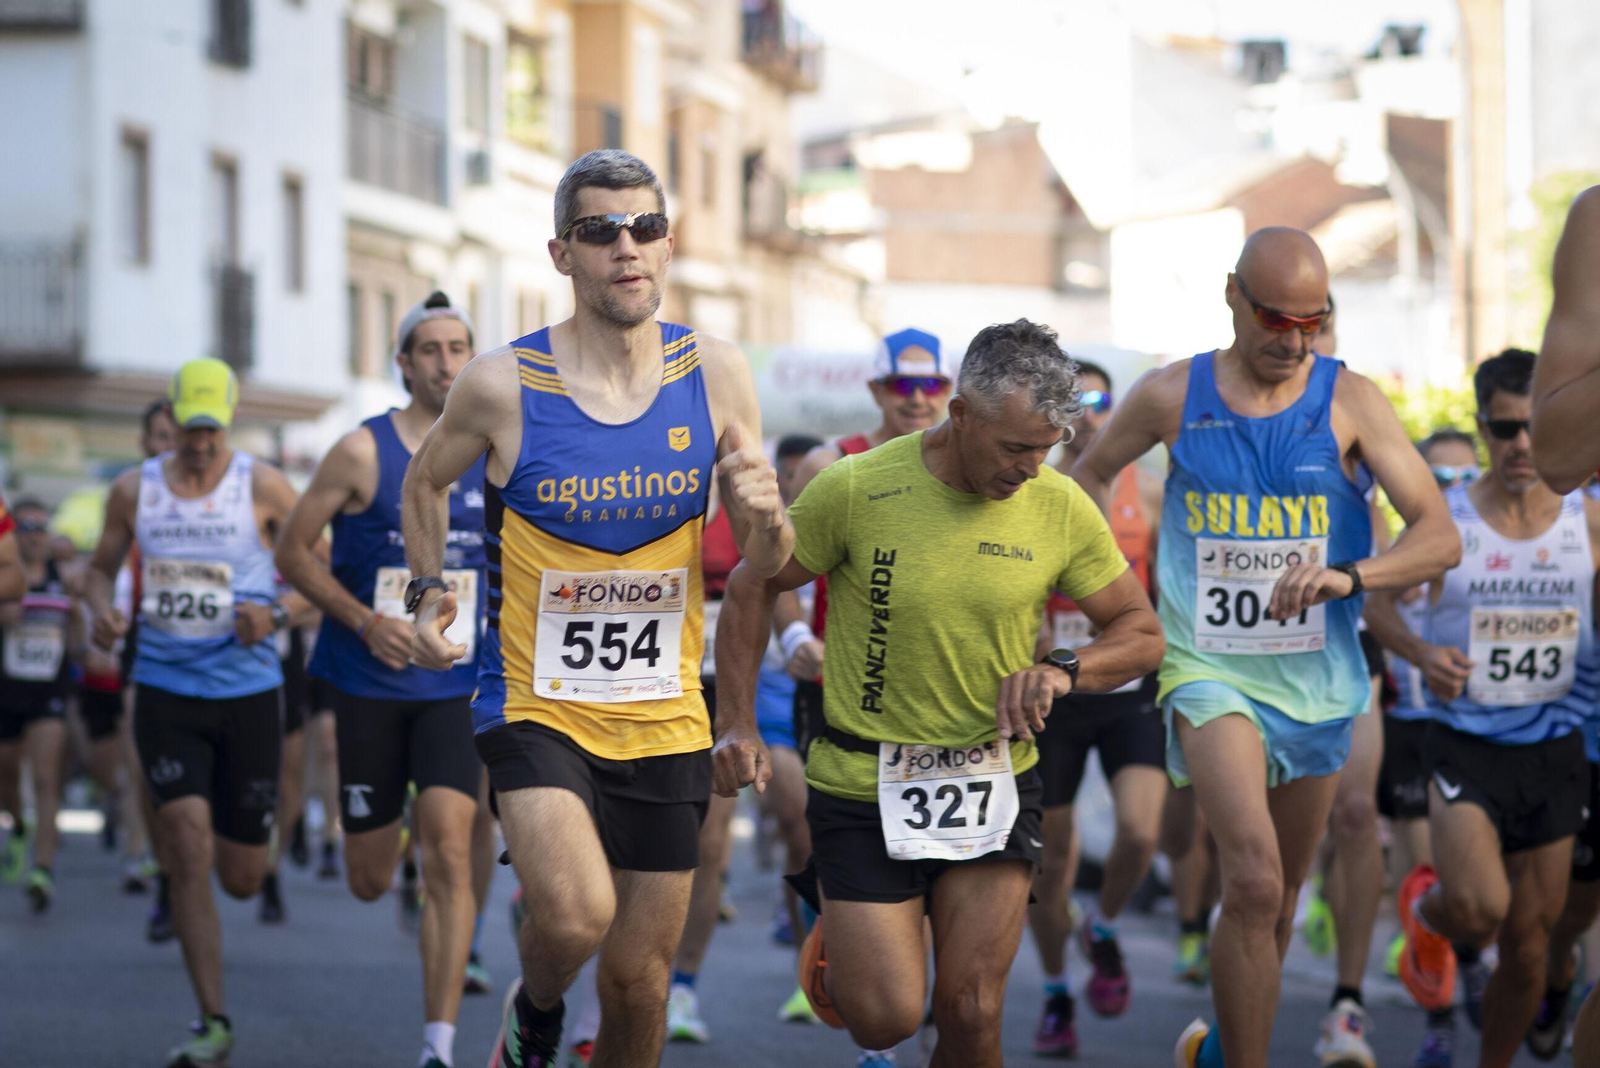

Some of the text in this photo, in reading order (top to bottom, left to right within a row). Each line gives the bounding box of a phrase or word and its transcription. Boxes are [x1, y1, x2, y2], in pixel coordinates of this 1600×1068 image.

[537, 465, 700, 512] agustinos
[564, 503, 677, 523] GRANADA
[1185, 490, 1330, 537] SULAYR
[978, 541, 1034, 562] MOLINA
[1225, 551, 1302, 571] FONDO
[576, 583, 662, 603] FONDO
[1467, 579, 1575, 596] MARACENA
[158, 590, 219, 620] 826
[860, 547, 897, 714] PANCIVERDE
[1495, 616, 1560, 635] FONDO
[560, 619, 661, 671] 554
[1488, 646, 1562, 682] 543
[901, 781, 993, 829] 327
